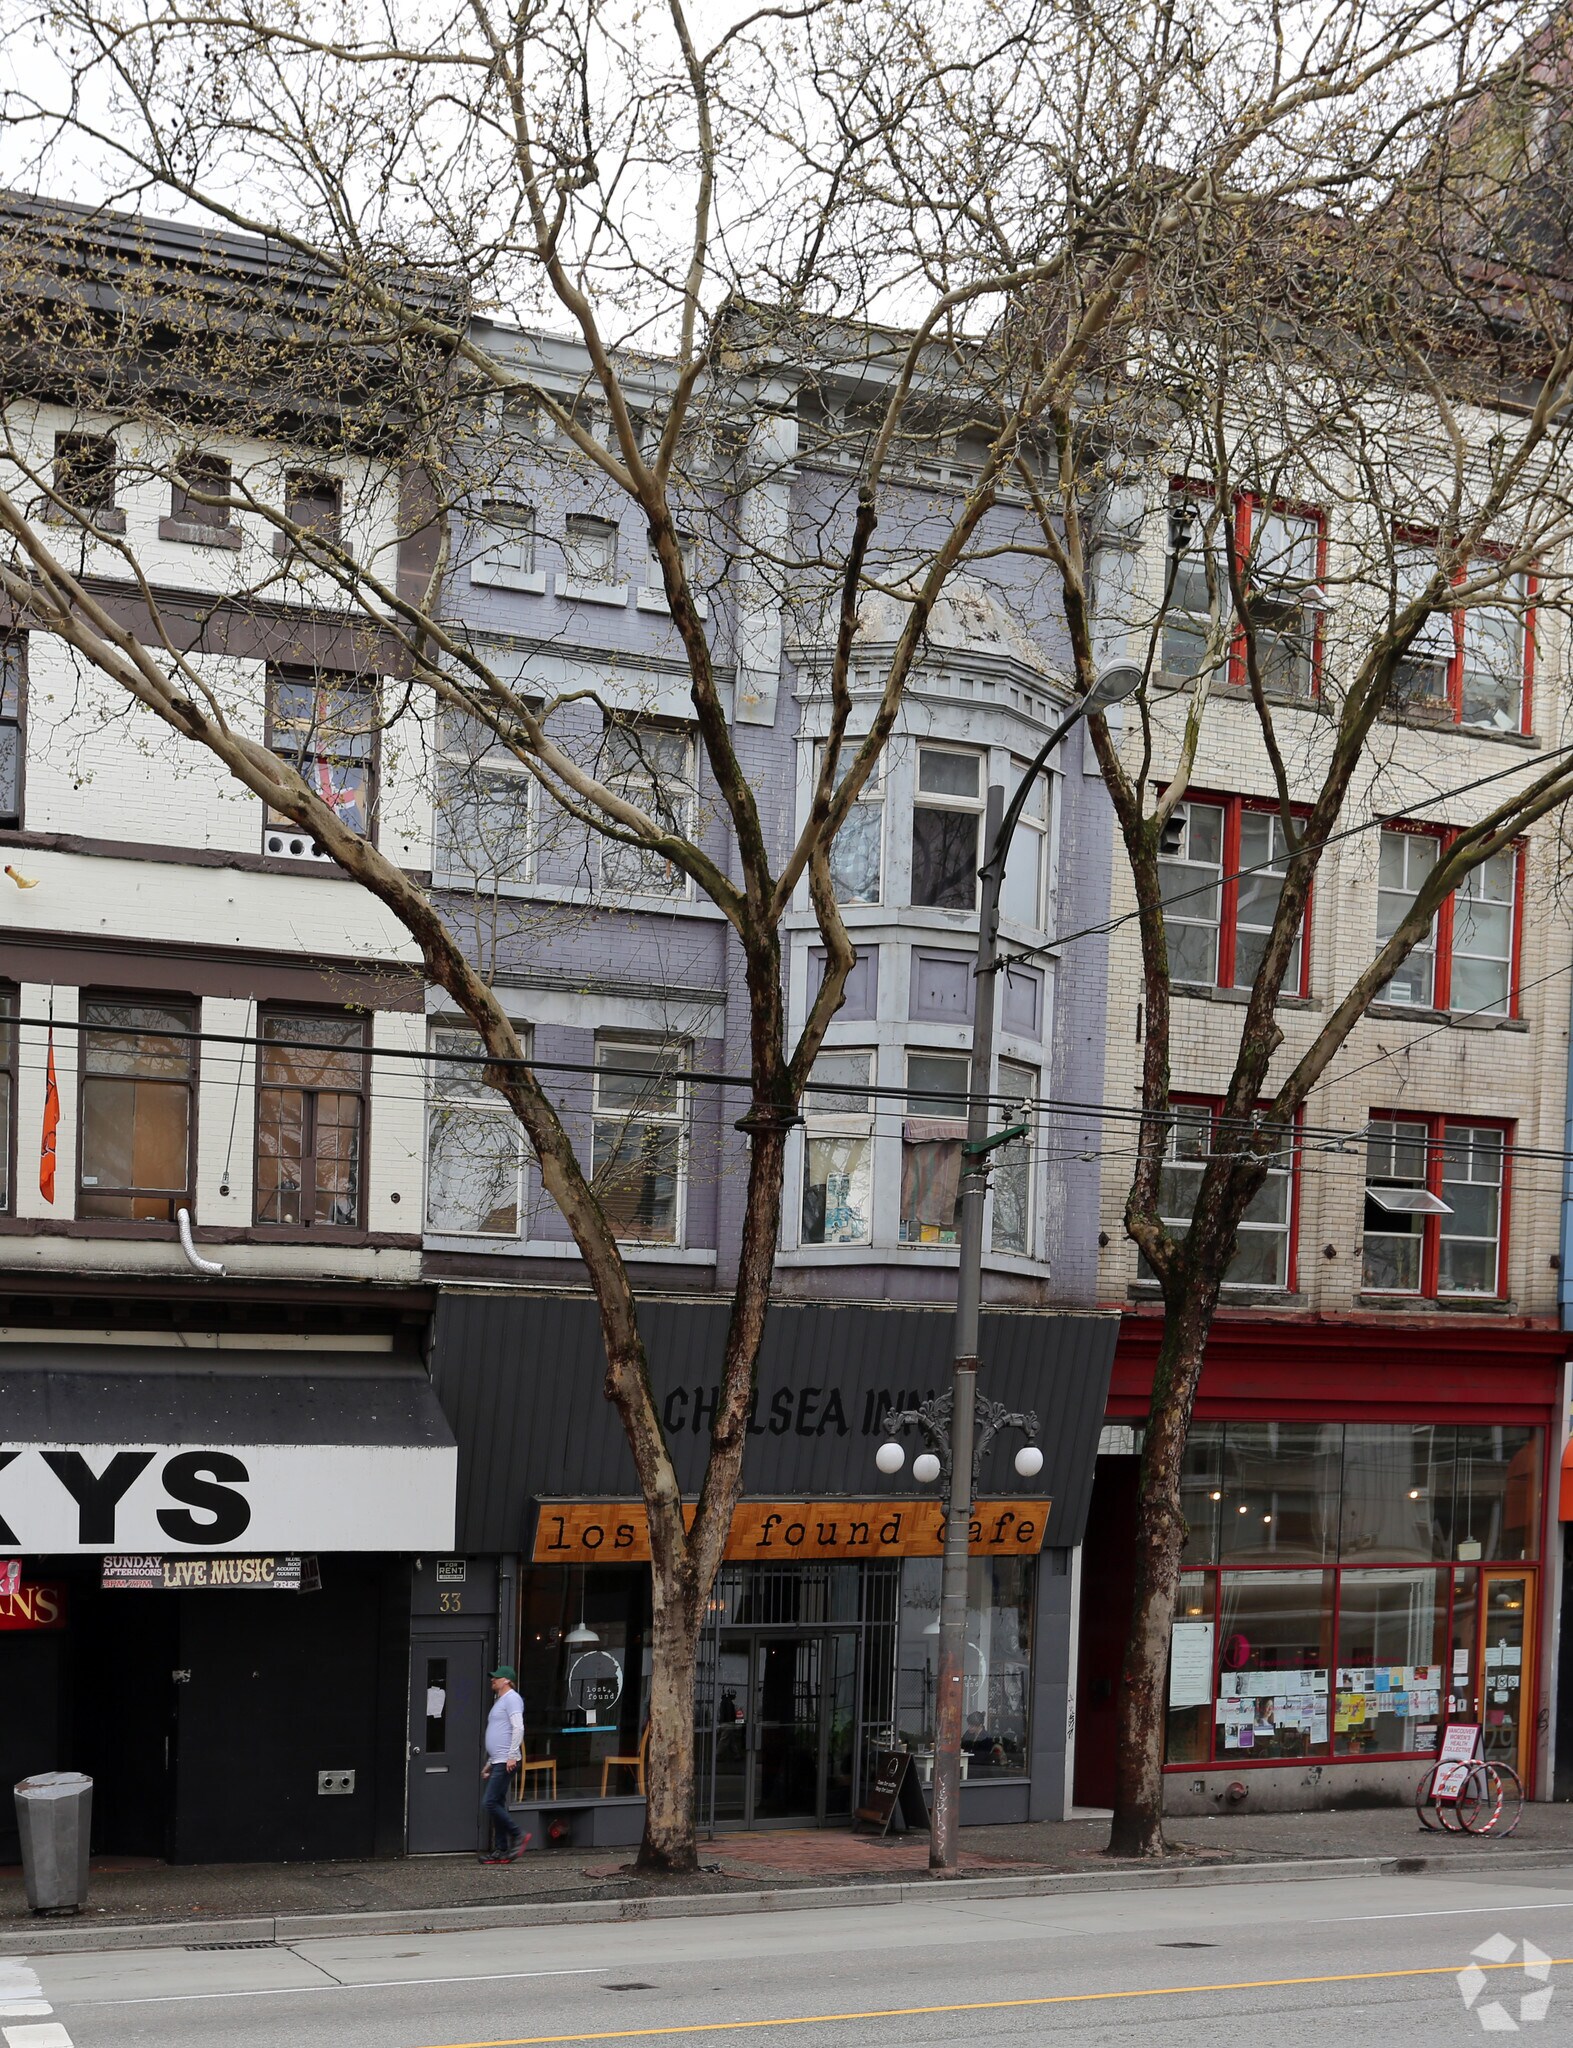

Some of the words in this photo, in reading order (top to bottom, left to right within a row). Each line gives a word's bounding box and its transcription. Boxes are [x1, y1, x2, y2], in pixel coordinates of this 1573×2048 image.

[662, 1386, 850, 1437] CHLSEA
[0, 1450, 251, 1545] YS
[548, 1516, 651, 1549] los
[756, 1514, 902, 1546] found
[103, 1556, 162, 1568] SUNDAY
[103, 1568, 162, 1576] AFTERNOONS
[163, 1561, 207, 1587] LIVE
[210, 1558, 275, 1585] MUSIC
[0, 1583, 58, 1623] N'S
[440, 1592, 461, 1612] 33
[1444, 1746, 1472, 1754] COLLECTIVE
